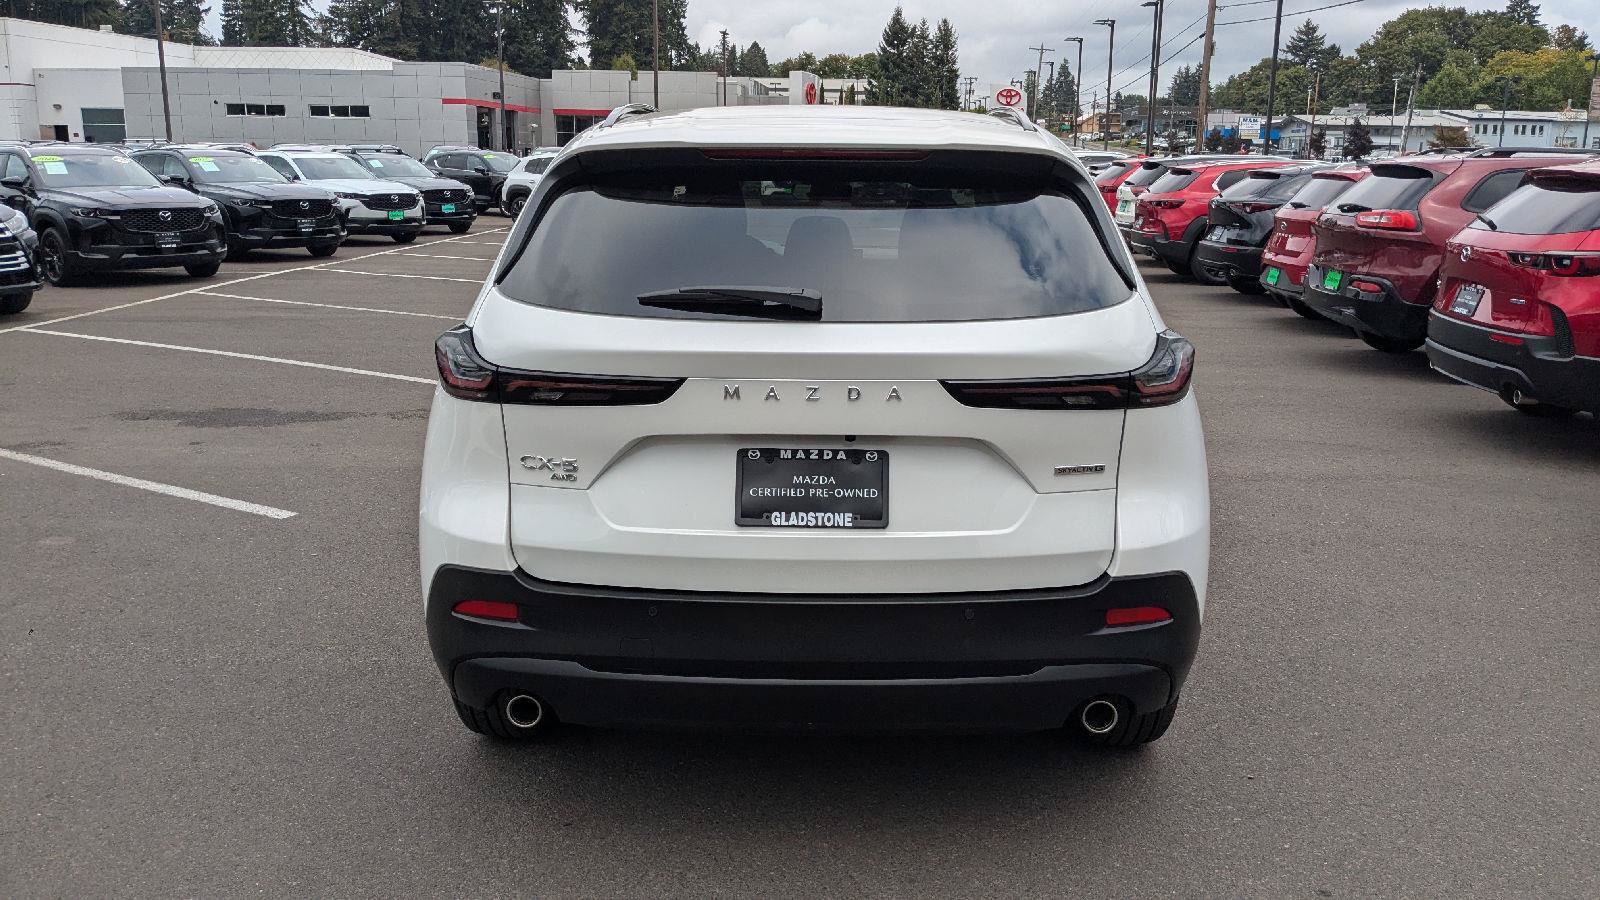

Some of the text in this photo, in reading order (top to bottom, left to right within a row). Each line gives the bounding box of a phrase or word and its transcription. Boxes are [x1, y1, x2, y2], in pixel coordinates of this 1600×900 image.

[723, 384, 903, 401] MAZDA
[780, 449, 847, 460] MAZDA
[520, 455, 579, 472] CX-5
[792, 475, 836, 485] MAZDA
[749, 487, 879, 498] CERTIFIED PRE-OWNED
[770, 511, 853, 527] GLADSTONE
